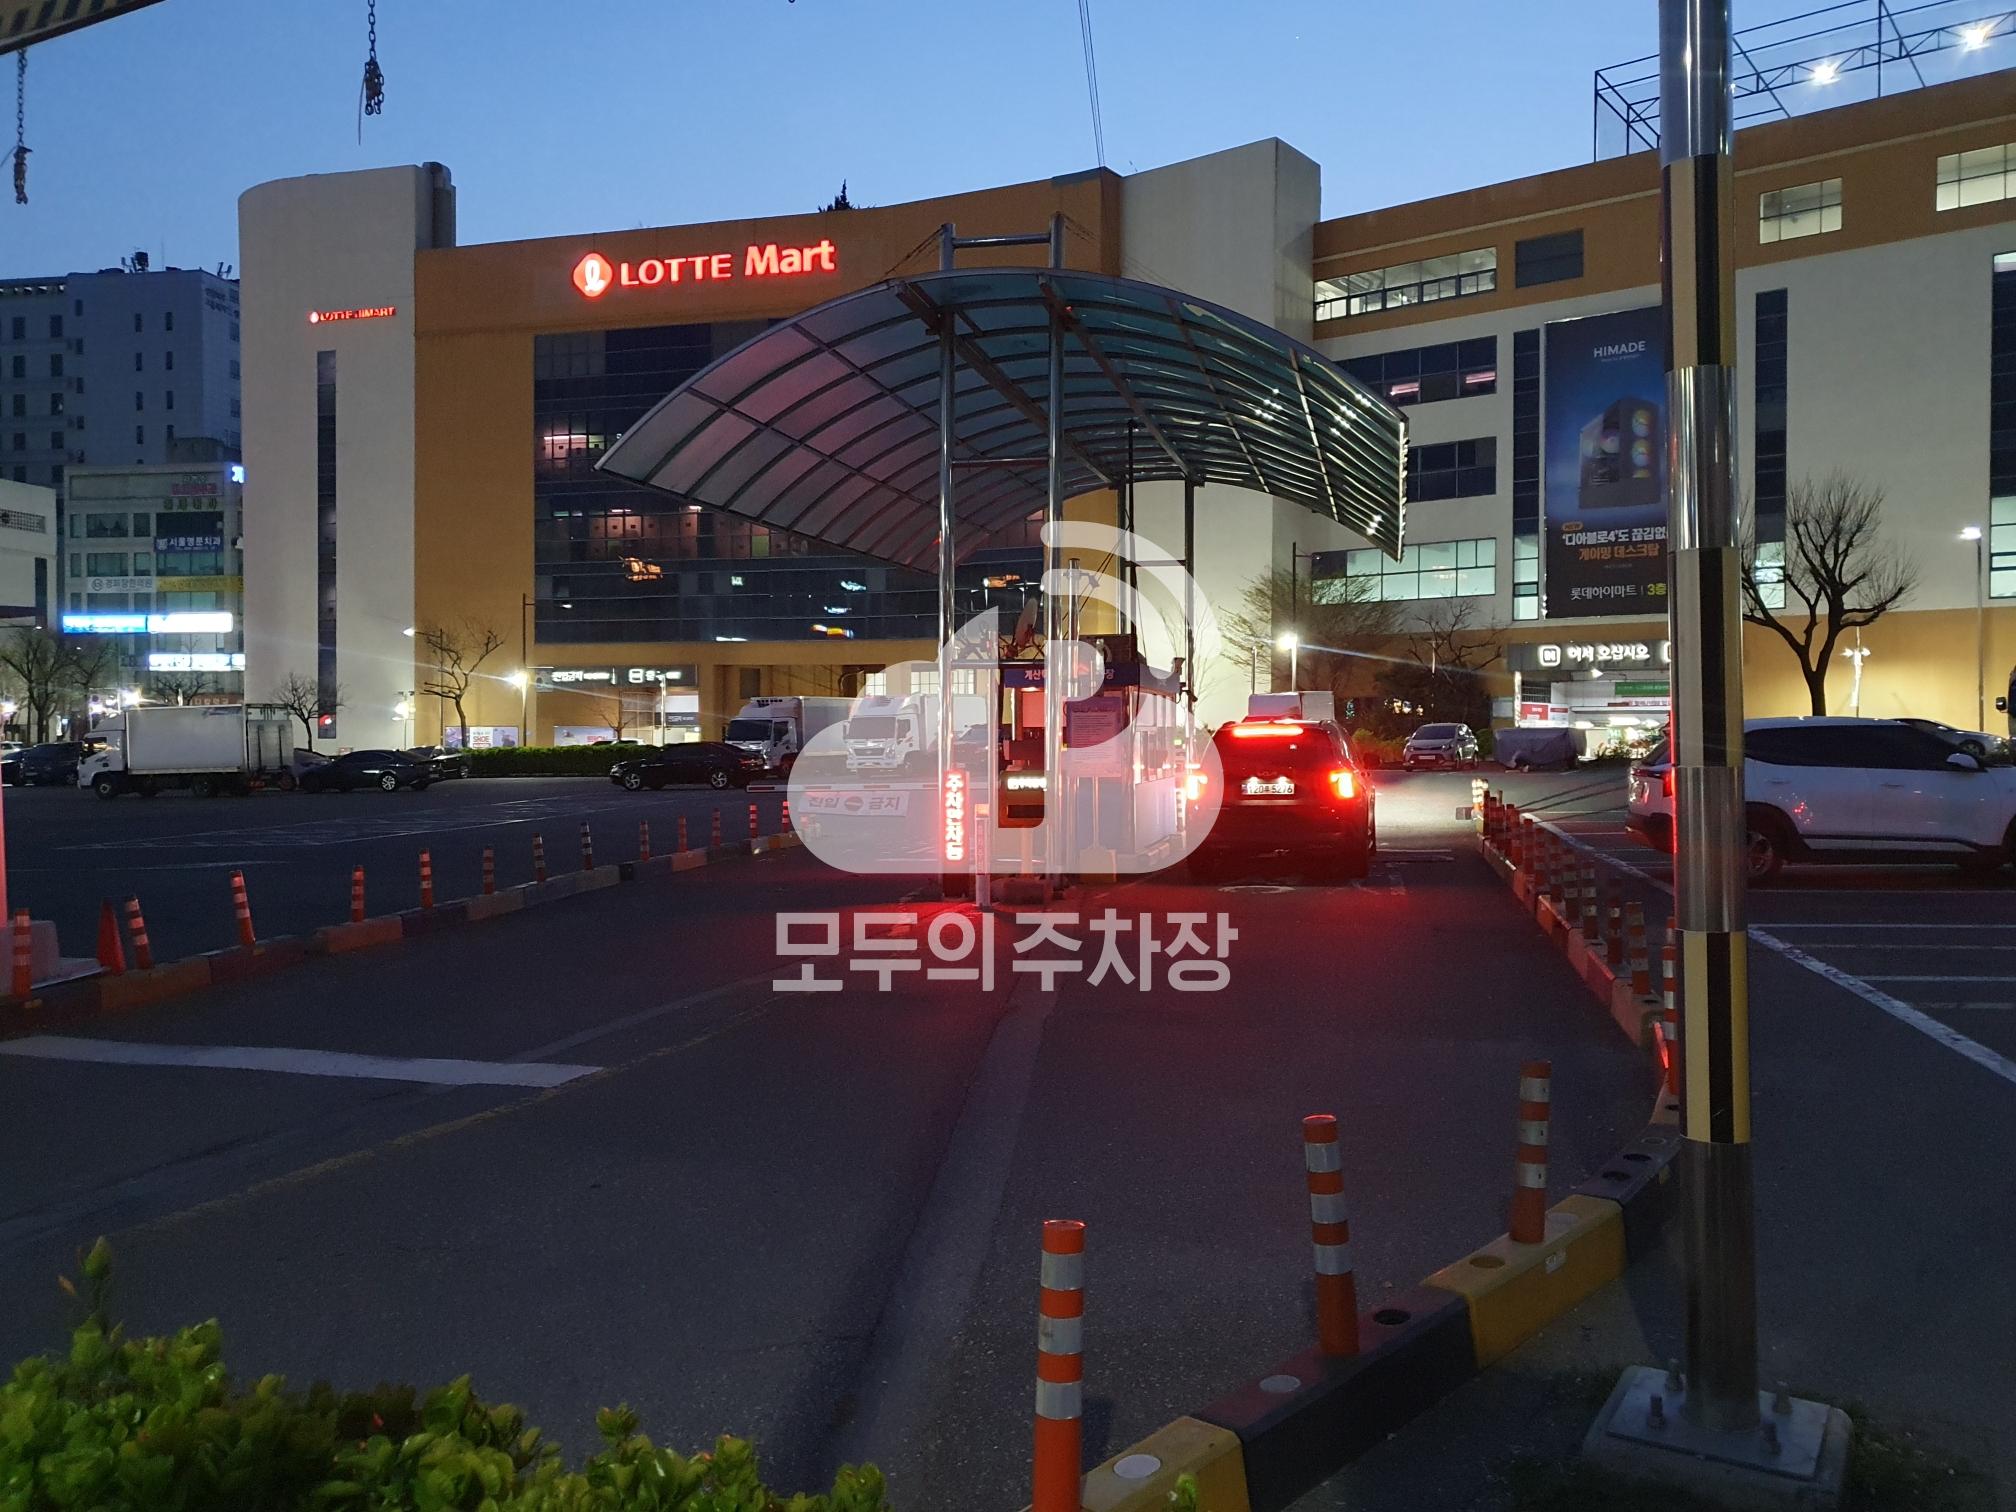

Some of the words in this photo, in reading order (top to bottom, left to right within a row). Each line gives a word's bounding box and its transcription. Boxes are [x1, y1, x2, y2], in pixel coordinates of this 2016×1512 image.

[620, 253, 732, 286] LOTTE
[745, 240, 835, 276] Mart
[320, 310, 352, 321] LOTTE
[1593, 341, 1646, 358] HIMADE
[1579, 547, 1611, 560] 게이밍
[1614, 543, 1660, 559] 데스크탑
[1570, 584, 1638, 600] 롯데하이마트
[1647, 583, 1667, 596] 3층
[1568, 645, 1595, 662] 어서
[1597, 643, 1650, 661] 오십시오
[809, 796, 840, 809] 진입
[868, 796, 900, 811] 금지
